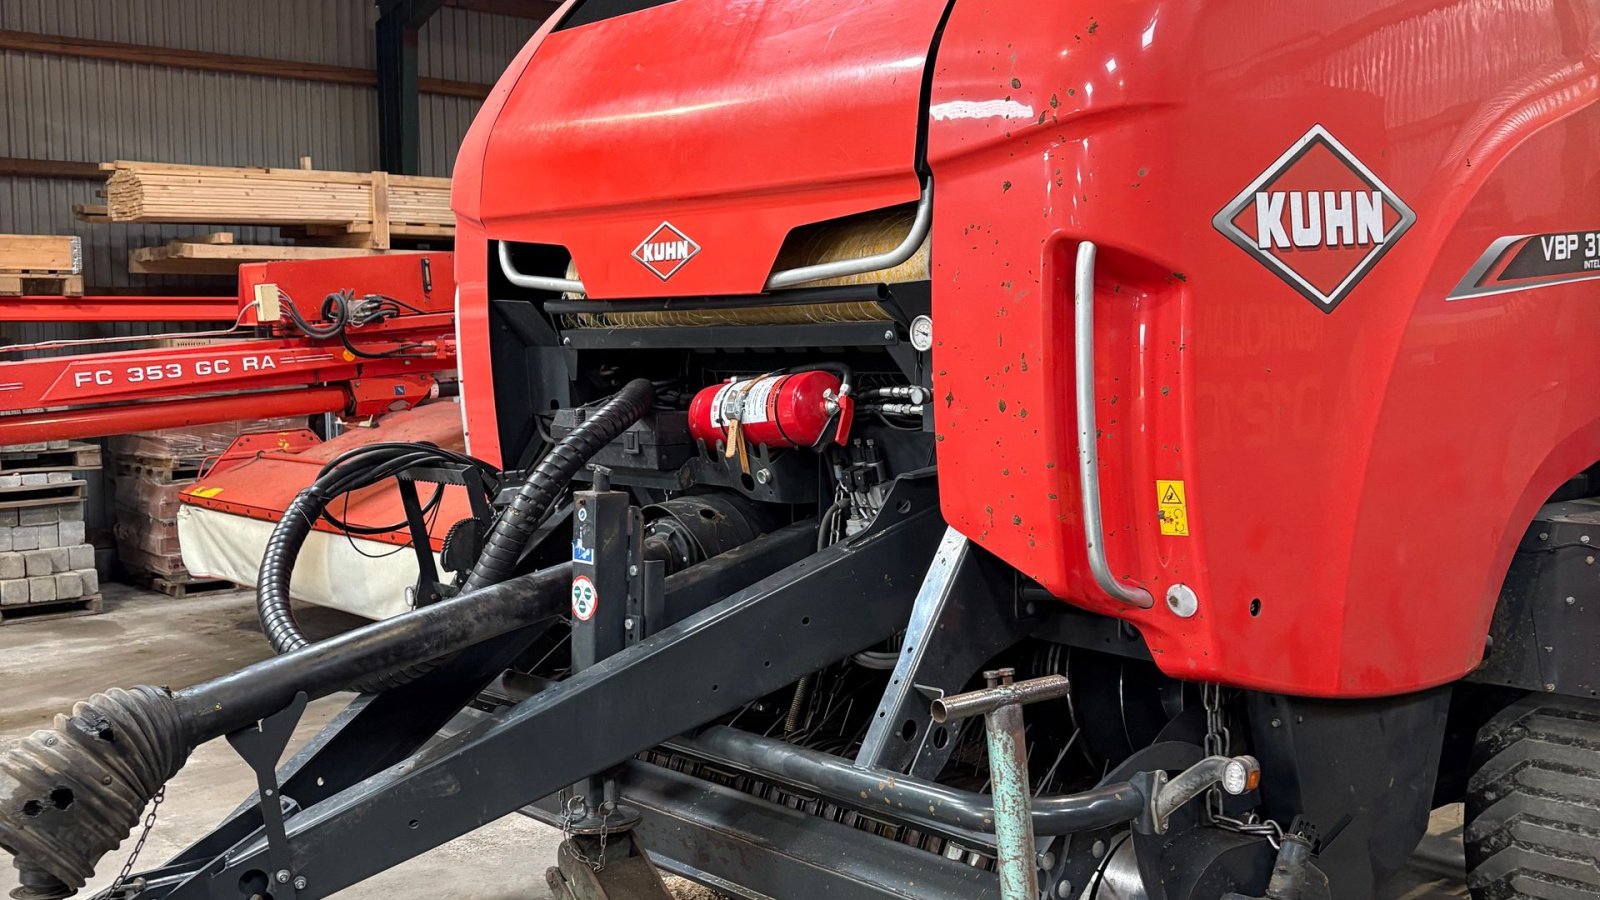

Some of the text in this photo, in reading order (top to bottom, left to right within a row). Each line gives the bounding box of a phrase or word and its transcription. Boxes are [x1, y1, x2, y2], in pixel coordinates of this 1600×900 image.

[1256, 191, 1384, 249] KUHN
[643, 240, 688, 262] KUHN
[1541, 234, 1579, 261] VBP
[74, 355, 277, 388] FC 353 GC RA
